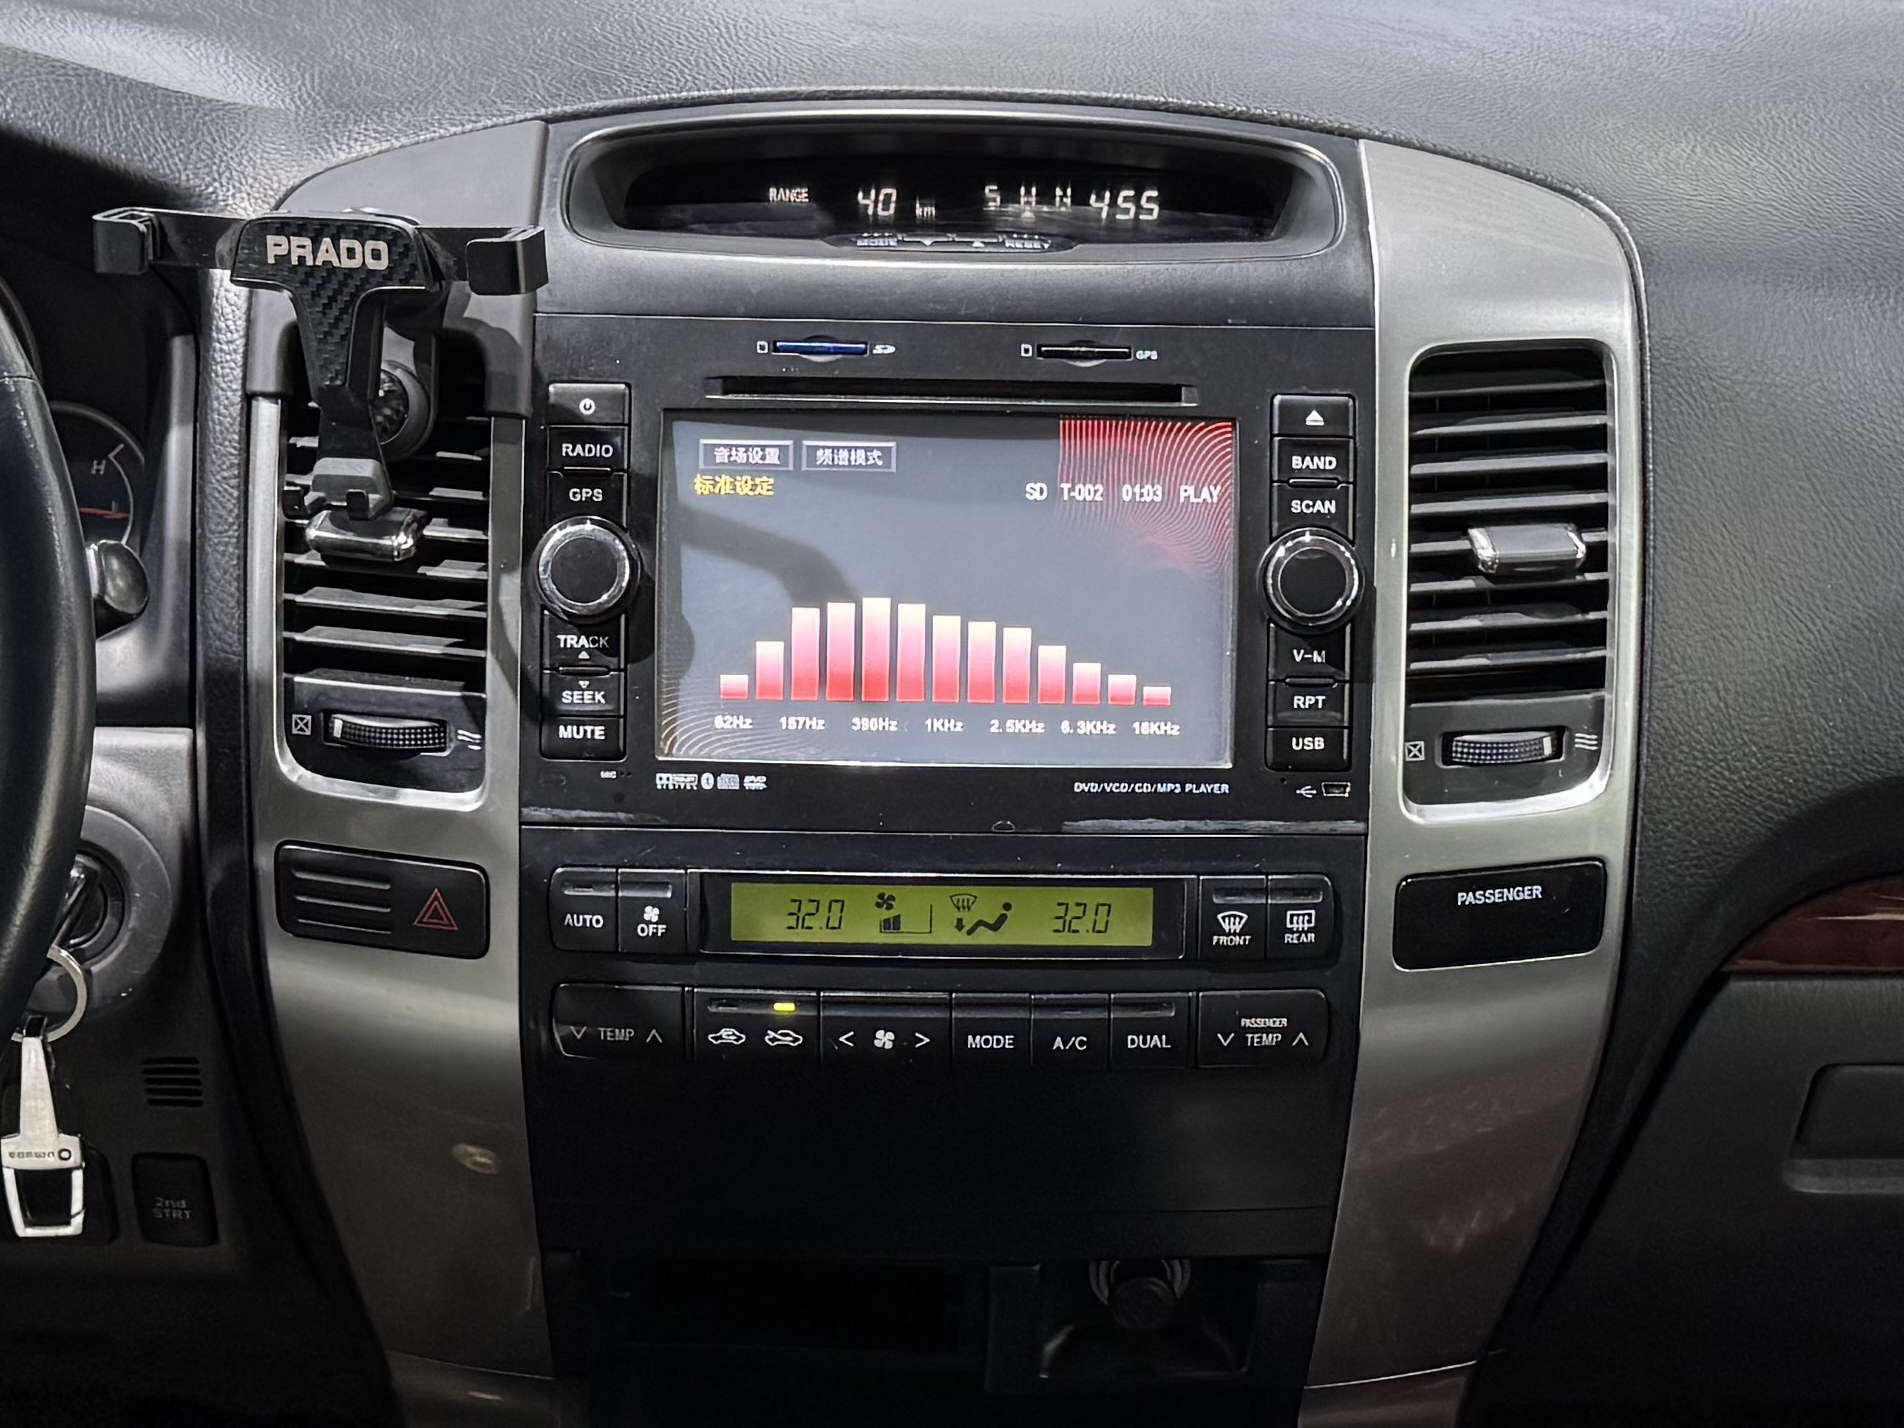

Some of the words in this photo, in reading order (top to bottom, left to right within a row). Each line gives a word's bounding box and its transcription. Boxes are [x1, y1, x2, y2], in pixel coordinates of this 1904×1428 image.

[768, 187, 809, 203] RANGE
[857, 187, 897, 216] 40
[915, 198, 936, 218] km
[265, 234, 390, 271] PRADO
[561, 442, 614, 459] RADIO
[714, 447, 781, 465] 音场设置
[815, 448, 884, 466] 频谱模式
[91, 459, 107, 475] H
[1291, 455, 1337, 471] BAND
[694, 474, 775, 496] 标准设定
[1025, 482, 1048, 501] SD
[1060, 482, 1103, 502] T-002
[1121, 483, 1163, 502] 01:03
[1179, 484, 1222, 503] PLAY
[568, 488, 604, 503] GPS
[1291, 499, 1336, 515] SCAN
[556, 635, 610, 649] TRACK
[1292, 649, 1326, 663] V-M
[561, 690, 606, 704] SEEK
[1293, 695, 1326, 710] RPT
[558, 724, 606, 740] MUTE
[925, 718, 964, 732] 1KHz
[1291, 736, 1325, 752] USB
[1073, 781, 1182, 794] DVD/VCD/CD/MP3
[1185, 782, 1230, 795] PLAYER
[1457, 885, 1543, 906] PASSENGER
[563, 913, 604, 929] AUTO
[786, 898, 845, 931] 32.0
[1052, 902, 1112, 934] 32.0
[637, 923, 667, 938] OFF
[1284, 932, 1316, 944] REAR
[1212, 934, 1252, 947] FRONT
[1240, 1017, 1289, 1028] PASSENGER
[598, 1027, 636, 1041] TEMP
[967, 1034, 1015, 1050] MODE
[1127, 1034, 1172, 1050] DUAL
[1245, 1032, 1282, 1047] TEMP
[1052, 1035, 1088, 1051] A/C
[154, 1196, 188, 1209] 2nd
[152, 1208, 193, 1220] STRT
